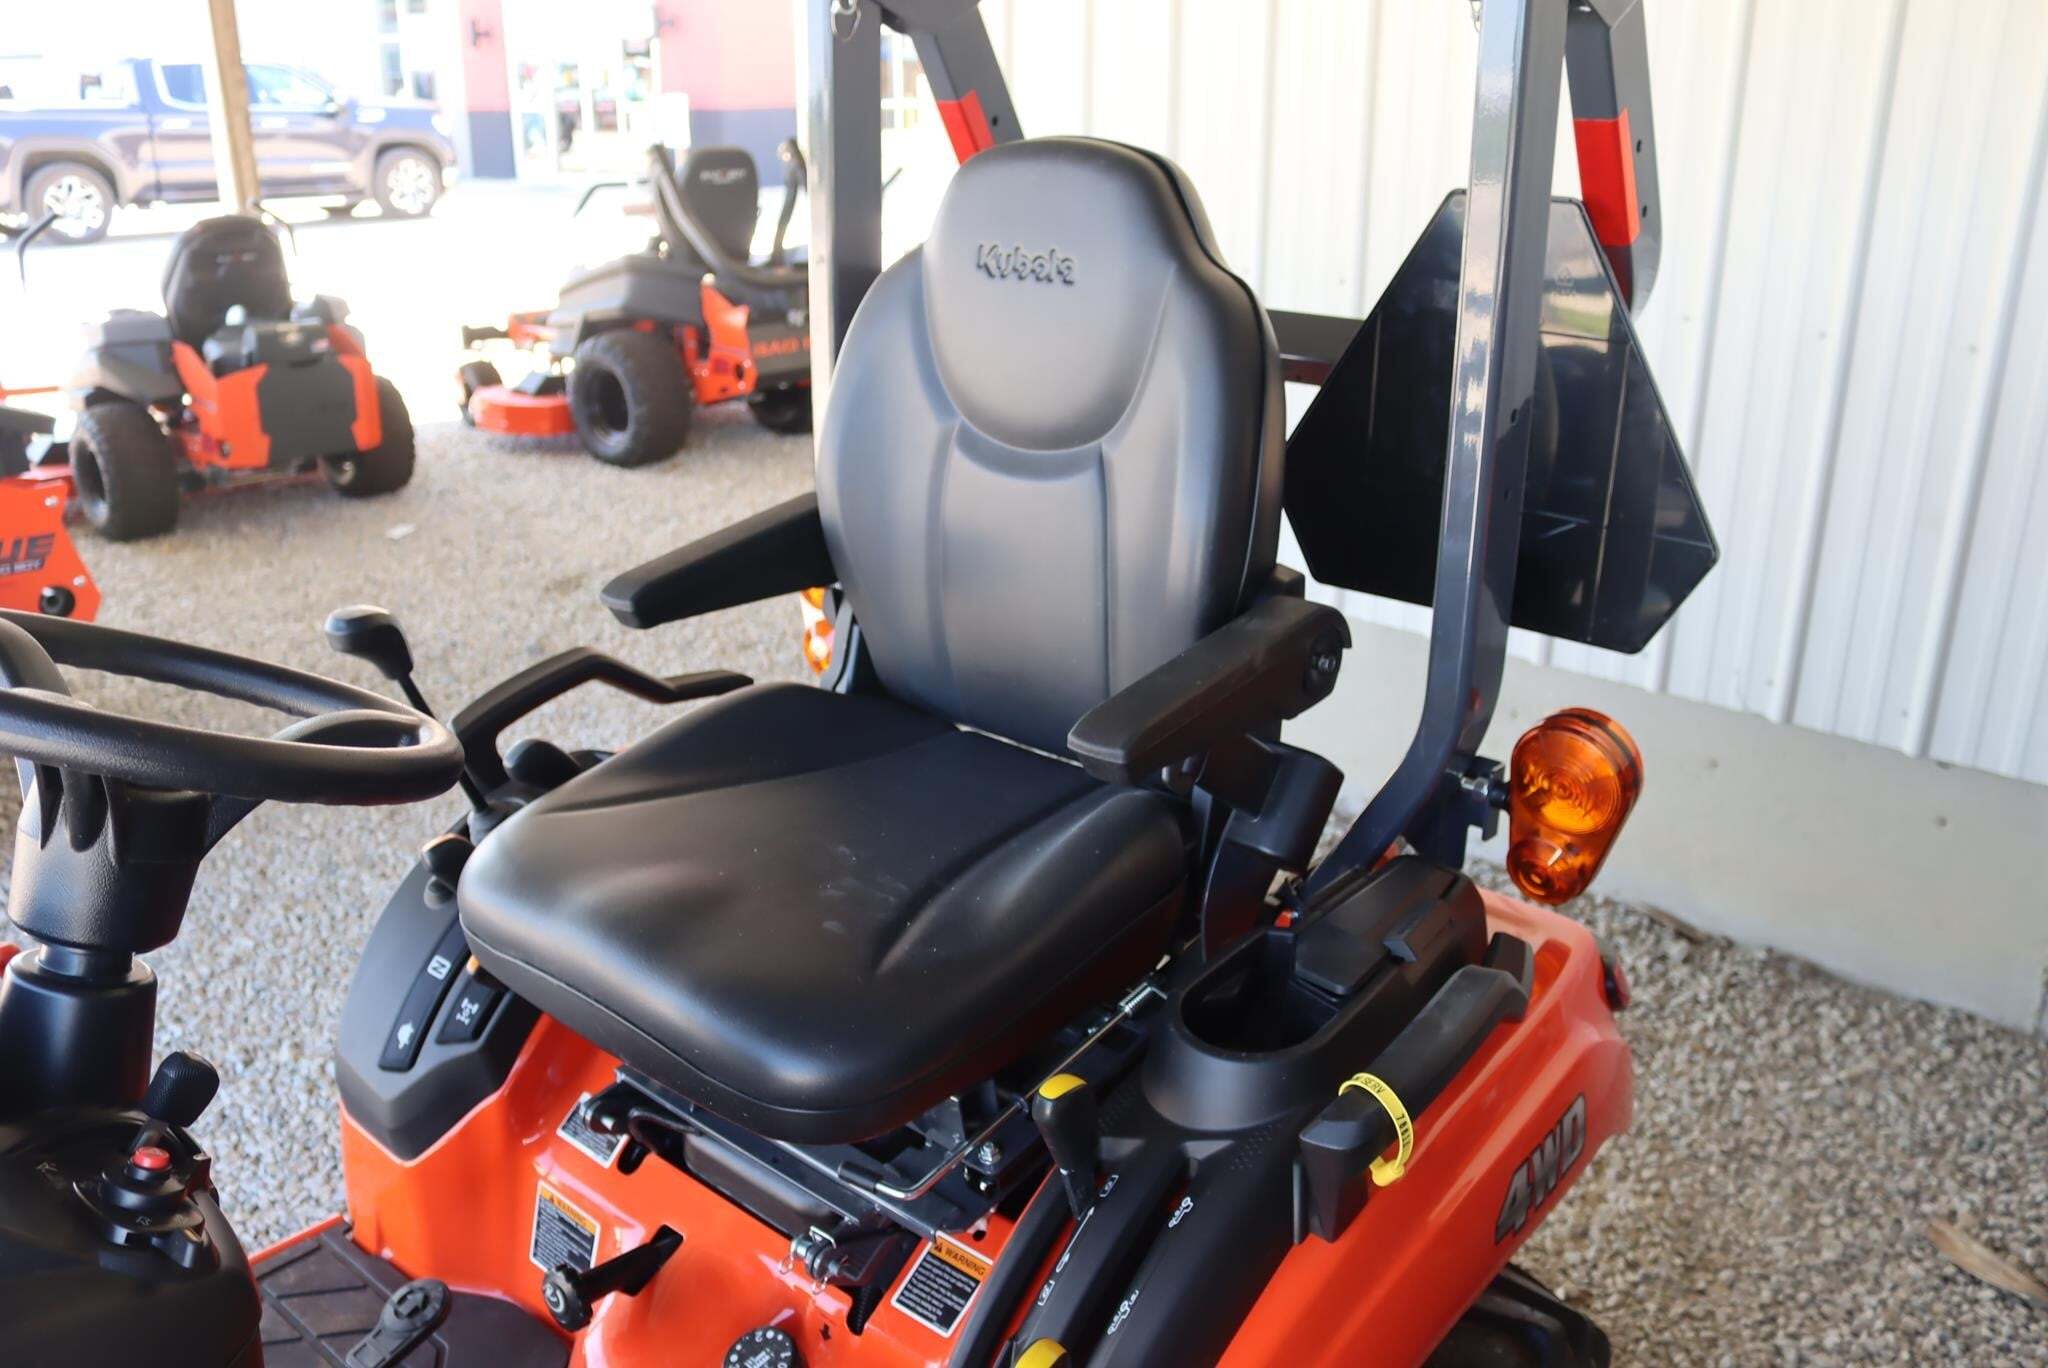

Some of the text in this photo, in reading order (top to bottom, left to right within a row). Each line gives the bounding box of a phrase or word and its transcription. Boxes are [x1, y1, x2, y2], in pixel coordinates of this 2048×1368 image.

[977, 244, 1076, 286] Kubota
[1495, 1092, 1587, 1245] 4WD
[944, 1247, 988, 1277] WARNING
